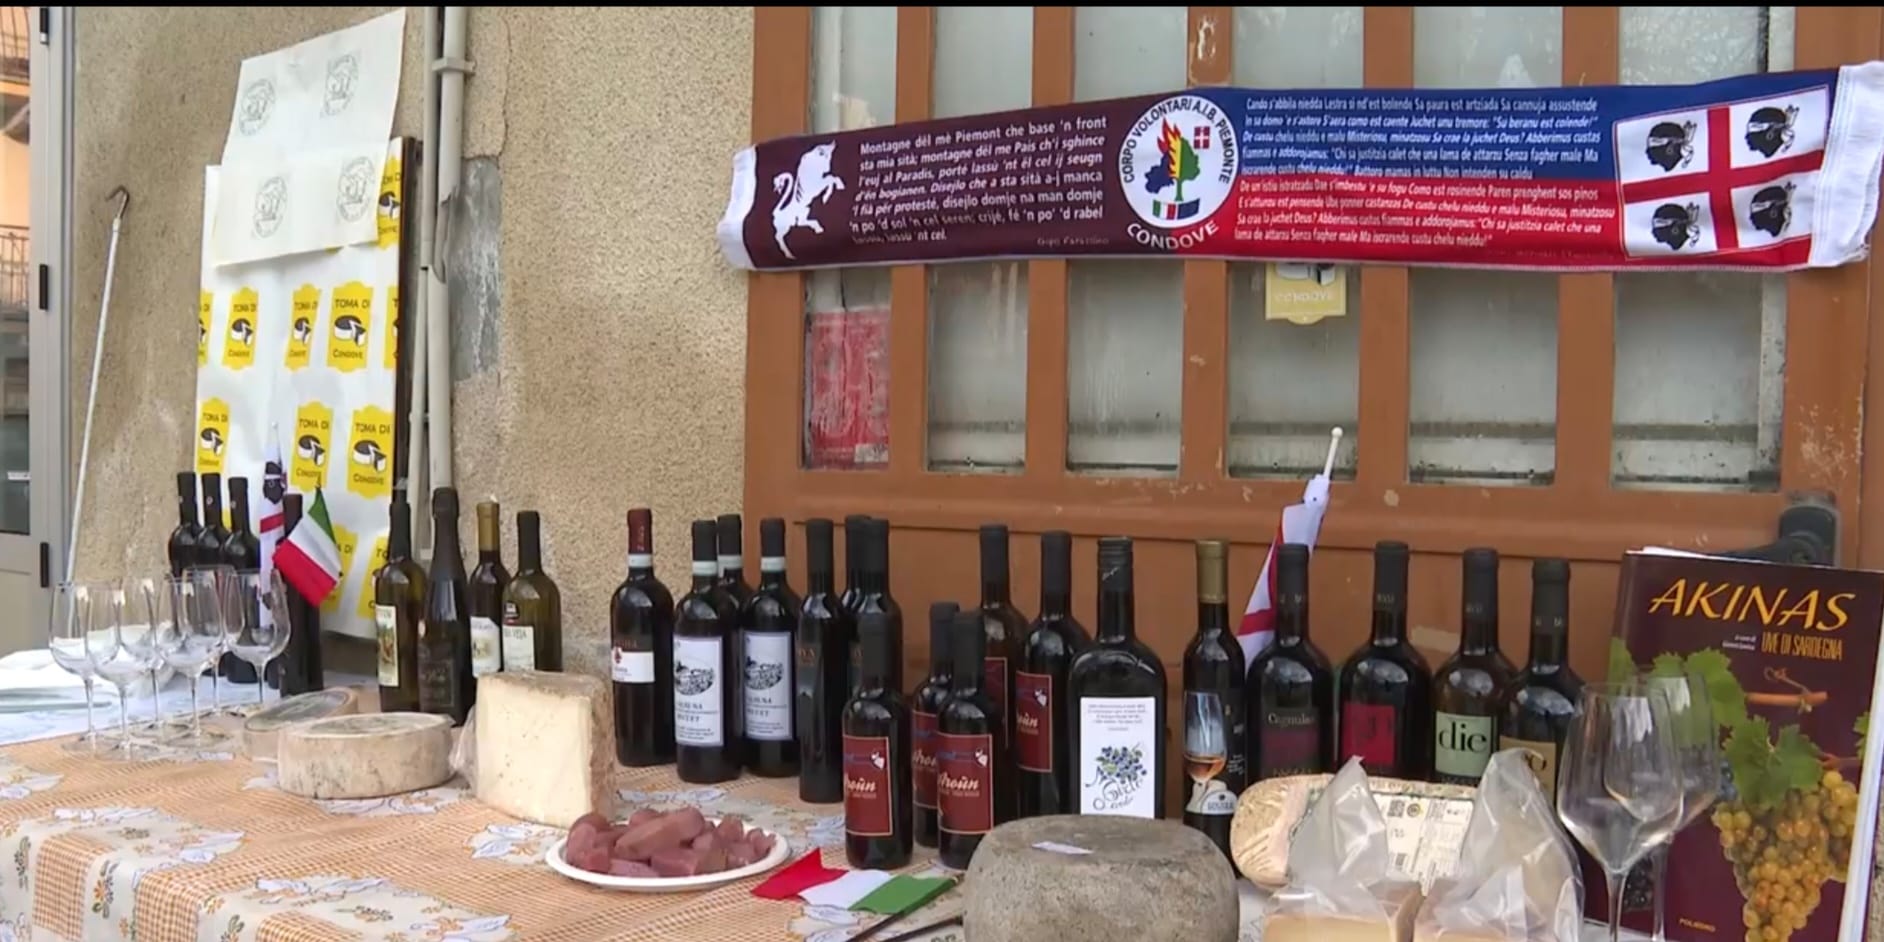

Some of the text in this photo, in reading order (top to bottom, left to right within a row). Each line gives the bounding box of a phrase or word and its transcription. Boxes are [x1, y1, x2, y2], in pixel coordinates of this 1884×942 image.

[1246, 97, 1268, 110] Cando
[1298, 97, 1322, 110] niedda
[1324, 97, 1347, 110] Lestra
[1415, 97, 1425, 111] Sa
[1426, 100, 1449, 116] paura
[1451, 97, 1463, 111] est
[1465, 97, 1499, 111] artziada
[1501, 97, 1511, 111] Sa
[1513, 97, 1546, 116] cannuja
[1549, 97, 1597, 111] assustende
[1263, 114, 1283, 127] domo
[1370, 115, 1382, 128] est
[1410, 115, 1436, 128] Juchet
[1437, 118, 1453, 128] unu
[1509, 116, 1539, 129] beranu
[1540, 116, 1554, 129] est
[860, 139, 911, 155] Montagne
[955, 126, 1000, 143] Piemont
[1005, 124, 1024, 138] che
[1028, 121, 1055, 136] base
[1060, 119, 1071, 132] 'n
[1076, 116, 1106, 130] front
[1121, 98, 1235, 185] CORPO VOLONTARI A.I.B. PIEMONTE
[1470, 132, 1498, 149] juchet
[1499, 132, 1525, 144] Deus?
[1525, 132, 1572, 144] Abberimus
[1573, 132, 1601, 144] custas
[859, 158, 874, 172] sta
[877, 155, 895, 169] mia
[920, 147, 973, 163] montagne
[1061, 134, 1105, 152] sghince
[1408, 147, 1421, 160] che
[1423, 151, 1438, 161] una
[1440, 148, 1459, 161] lama
[1461, 148, 1471, 161] de
[1504, 148, 1529, 161] Senza
[1530, 148, 1559, 167] fagher
[1561, 148, 1582, 162] male
[1584, 148, 1599, 162] Ma
[883, 172, 893, 184] al
[1034, 154, 1052, 167] cel
[1067, 152, 1104, 168] seugn
[1510, 167, 1533, 179] caldu
[969, 176, 989, 190] che
[989, 178, 998, 188] a
[1000, 175, 1018, 188] sta
[1020, 170, 1042, 186] sità
[1063, 171, 1104, 184] manca
[981, 191, 1016, 208] domje
[1019, 192, 1035, 204] na
[1037, 190, 1064, 203] man
[1066, 186, 1104, 204] domje
[1388, 182, 1407, 200] fogu
[1408, 183, 1431, 196] Como
[1433, 184, 1445, 197] est
[1558, 190, 1572, 200] sos
[1574, 188, 1598, 206] pinos
[923, 213, 939, 226] cel
[1023, 208, 1035, 222] 'n
[1037, 207, 1055, 224] po'
[1060, 206, 1071, 220] 'd
[1074, 204, 1103, 219] rabel
[1402, 199, 1414, 211] De
[1569, 205, 1615, 219] minatzosu
[930, 227, 947, 241] cel.
[1317, 213, 1358, 226] Abberimus
[1496, 220, 1507, 231] sa
[1544, 220, 1566, 233] calet
[1567, 221, 1582, 234] che
[1584, 225, 1602, 235] una
[1127, 219, 1219, 250] CONDOVE
[1339, 231, 1358, 243] male
[335, 298, 359, 309] TOMA
[299, 418, 330, 430] TOMA DI
[355, 422, 376, 433] TOMA
[376, 548, 389, 560] TO
[1648, 578, 1855, 632] AKINAS
[1761, 631, 1779, 655] UVE
[1780, 633, 1793, 657] DI
[1792, 634, 1844, 662] SARDEGNA
[1438, 721, 1487, 753] die
